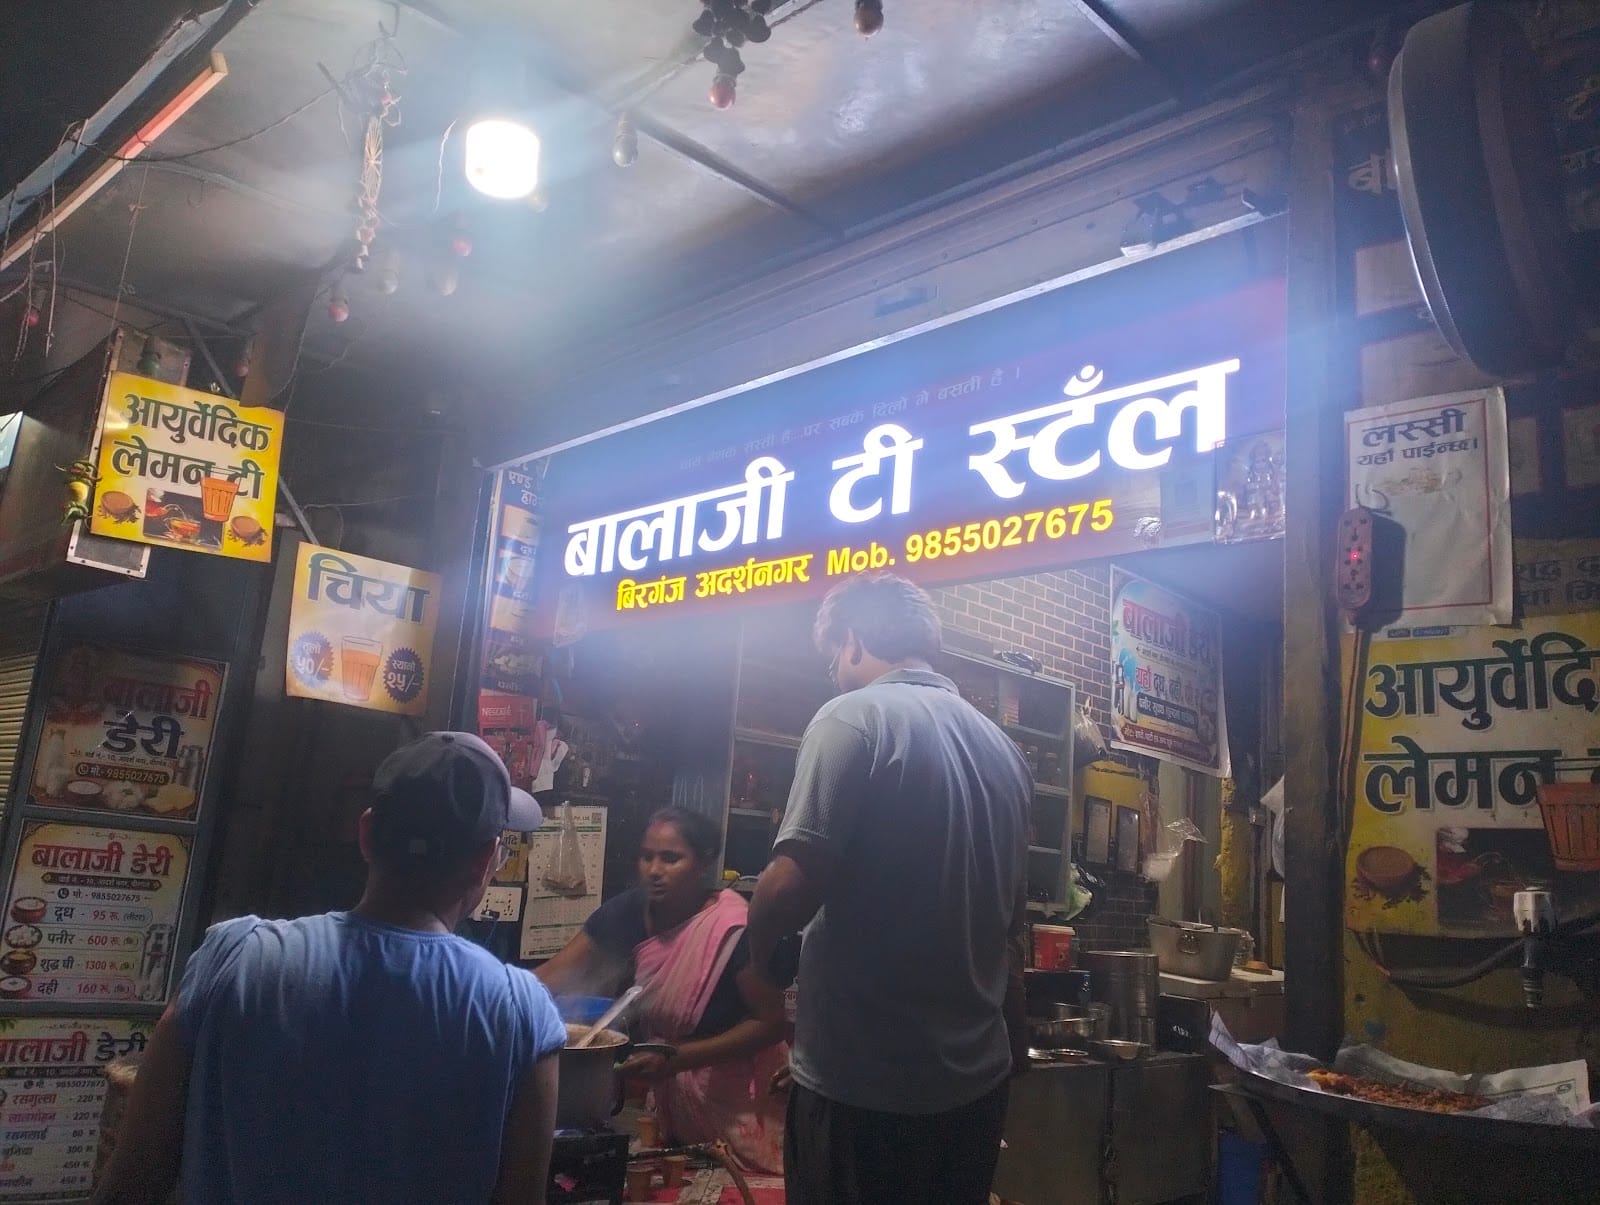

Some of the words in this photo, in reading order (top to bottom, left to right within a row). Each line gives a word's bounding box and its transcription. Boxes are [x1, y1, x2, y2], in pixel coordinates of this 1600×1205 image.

[937, 375, 981, 400] बसती
[120, 392, 273, 452] आयुर्वेदिक
[1362, 408, 1467, 448] लस्सी
[226, 459, 265, 500] टी
[564, 456, 795, 576] बालाजी
[828, 423, 924, 524] टी
[616, 575, 687, 611] बिरगंज
[826, 545, 896, 577] Mob.
[905, 498, 1114, 563] 9855027675
[307, 552, 431, 624] चिया
[1364, 632, 1600, 731] आयुर्वेदि
[102, 710, 186, 760] डेरी
[32, 840, 124, 874] बालाजी
[130, 844, 174, 877] डेरी
[54, 906, 76, 922] दूध
[92, 909, 107, 921] 95
[47, 930, 76, 945] पनीर
[87, 935, 108, 947] 600
[85, 959, 107, 971] 1300
[37, 979, 59, 995] दही
[77, 983, 97, 994] 160
